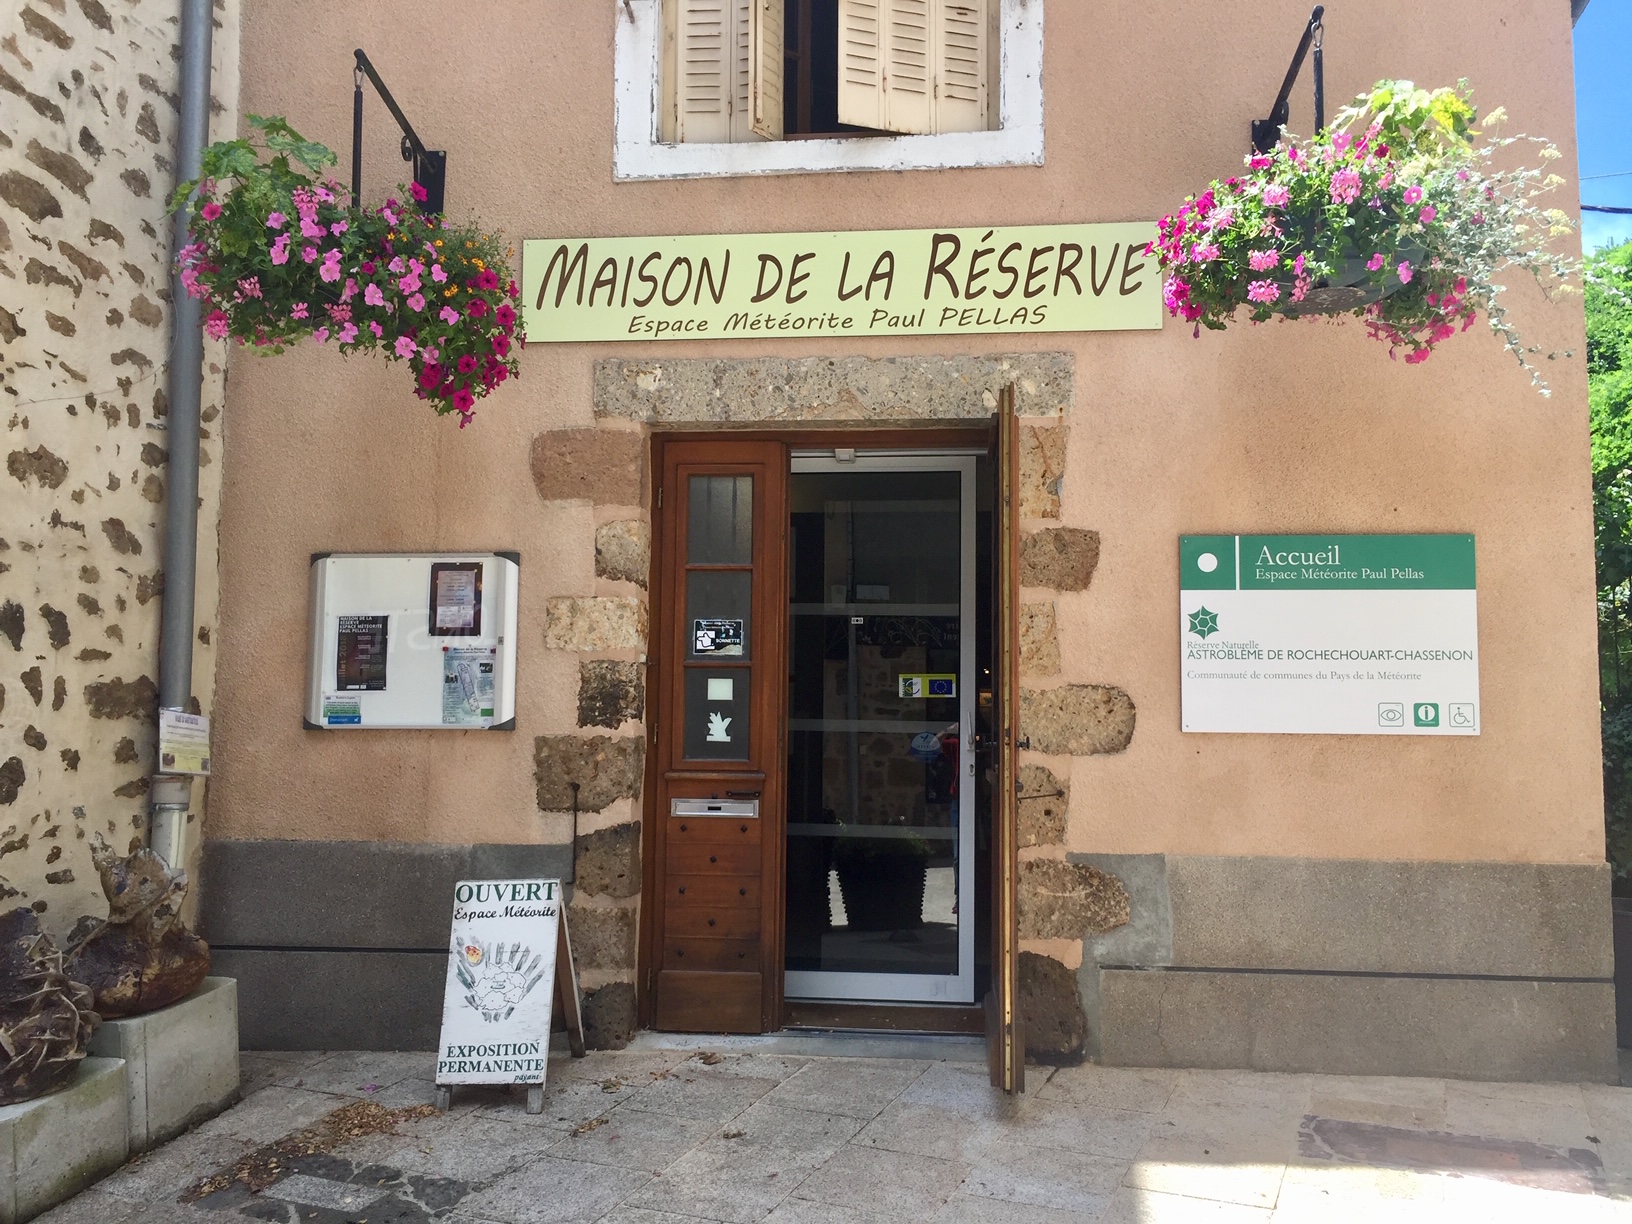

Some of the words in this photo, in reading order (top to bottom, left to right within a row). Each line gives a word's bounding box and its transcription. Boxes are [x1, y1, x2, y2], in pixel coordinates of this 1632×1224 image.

[536, 242, 731, 310] MAISON
[750, 252, 816, 304] DE
[837, 250, 895, 301] LA
[923, 230, 1151, 300] RÉSERVE
[628, 315, 709, 338] Espace
[723, 310, 854, 333] Météorite
[869, 307, 926, 329] Paul
[939, 304, 1048, 327] PELLAS
[1255, 544, 1341, 566] Accueil
[1255, 568, 1298, 582] Espace
[1301, 567, 1358, 579] Météorite
[1361, 567, 1387, 579] Paul
[1391, 567, 1425, 579] Pellas
[1187, 640, 1220, 649] Réserve
[1222, 640, 1260, 649] Naturelle
[1267, 649, 1284, 660] DE
[1287, 649, 1473, 661] ROCHECHOUART-CHASSENON
[1187, 670, 1248, 680] Communauté
[1250, 670, 1261, 680] de
[1263, 671, 1313, 680] communes
[1315, 670, 1328, 680] du
[1330, 671, 1351, 682] Pays
[1353, 671, 1364, 680] de
[1366, 671, 1375, 680] la
[1377, 671, 1422, 681] Météorite
[455, 882, 559, 903] OUVERT
[454, 907, 497, 922] Espace
[499, 905, 557, 918] Météorite
[446, 1042, 540, 1058] EXPOSITION
[438, 1059, 544, 1073] PERMANENTE
